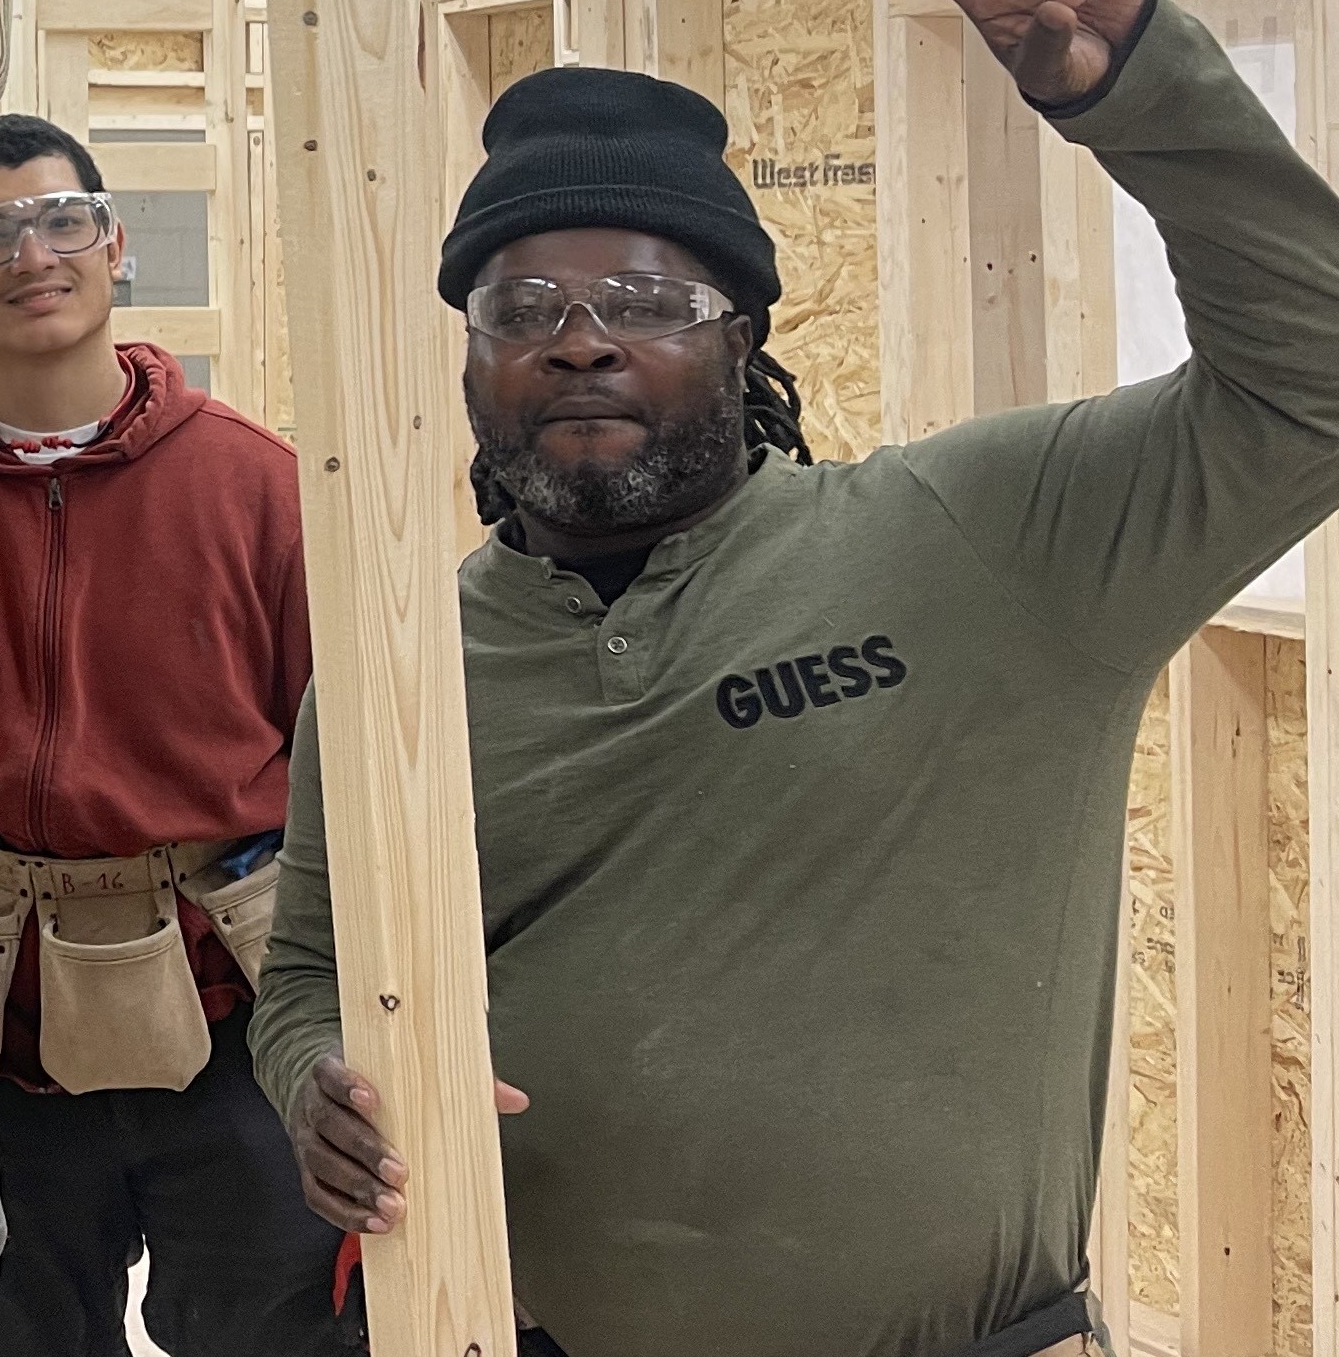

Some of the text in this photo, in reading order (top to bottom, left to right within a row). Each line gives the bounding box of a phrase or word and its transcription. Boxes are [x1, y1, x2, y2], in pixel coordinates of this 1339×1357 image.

[752, 153, 876, 190] West Fras
[716, 634, 908, 729] GUESS
